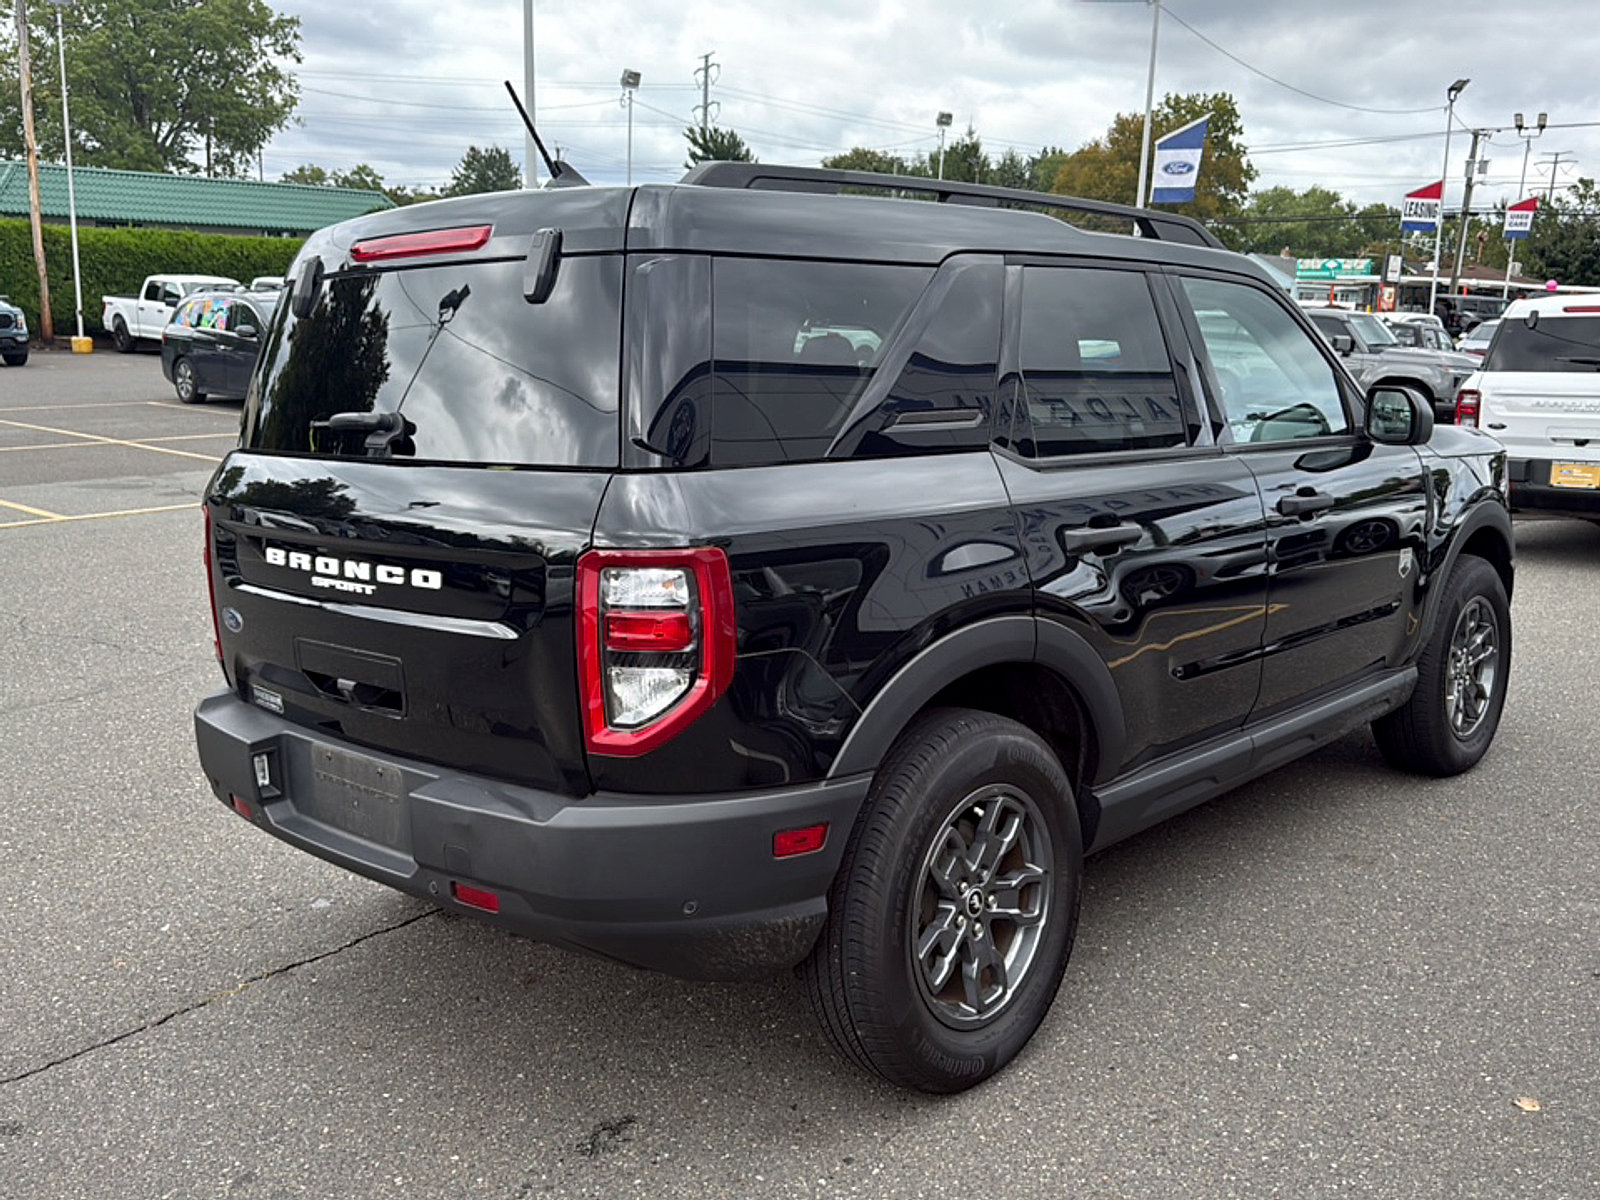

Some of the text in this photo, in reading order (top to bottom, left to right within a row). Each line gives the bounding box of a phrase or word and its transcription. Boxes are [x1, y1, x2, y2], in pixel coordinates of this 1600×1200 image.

[1402, 201, 1440, 219] LEASING
[265, 547, 442, 590] BRONCO
[311, 576, 377, 595] SPORT
